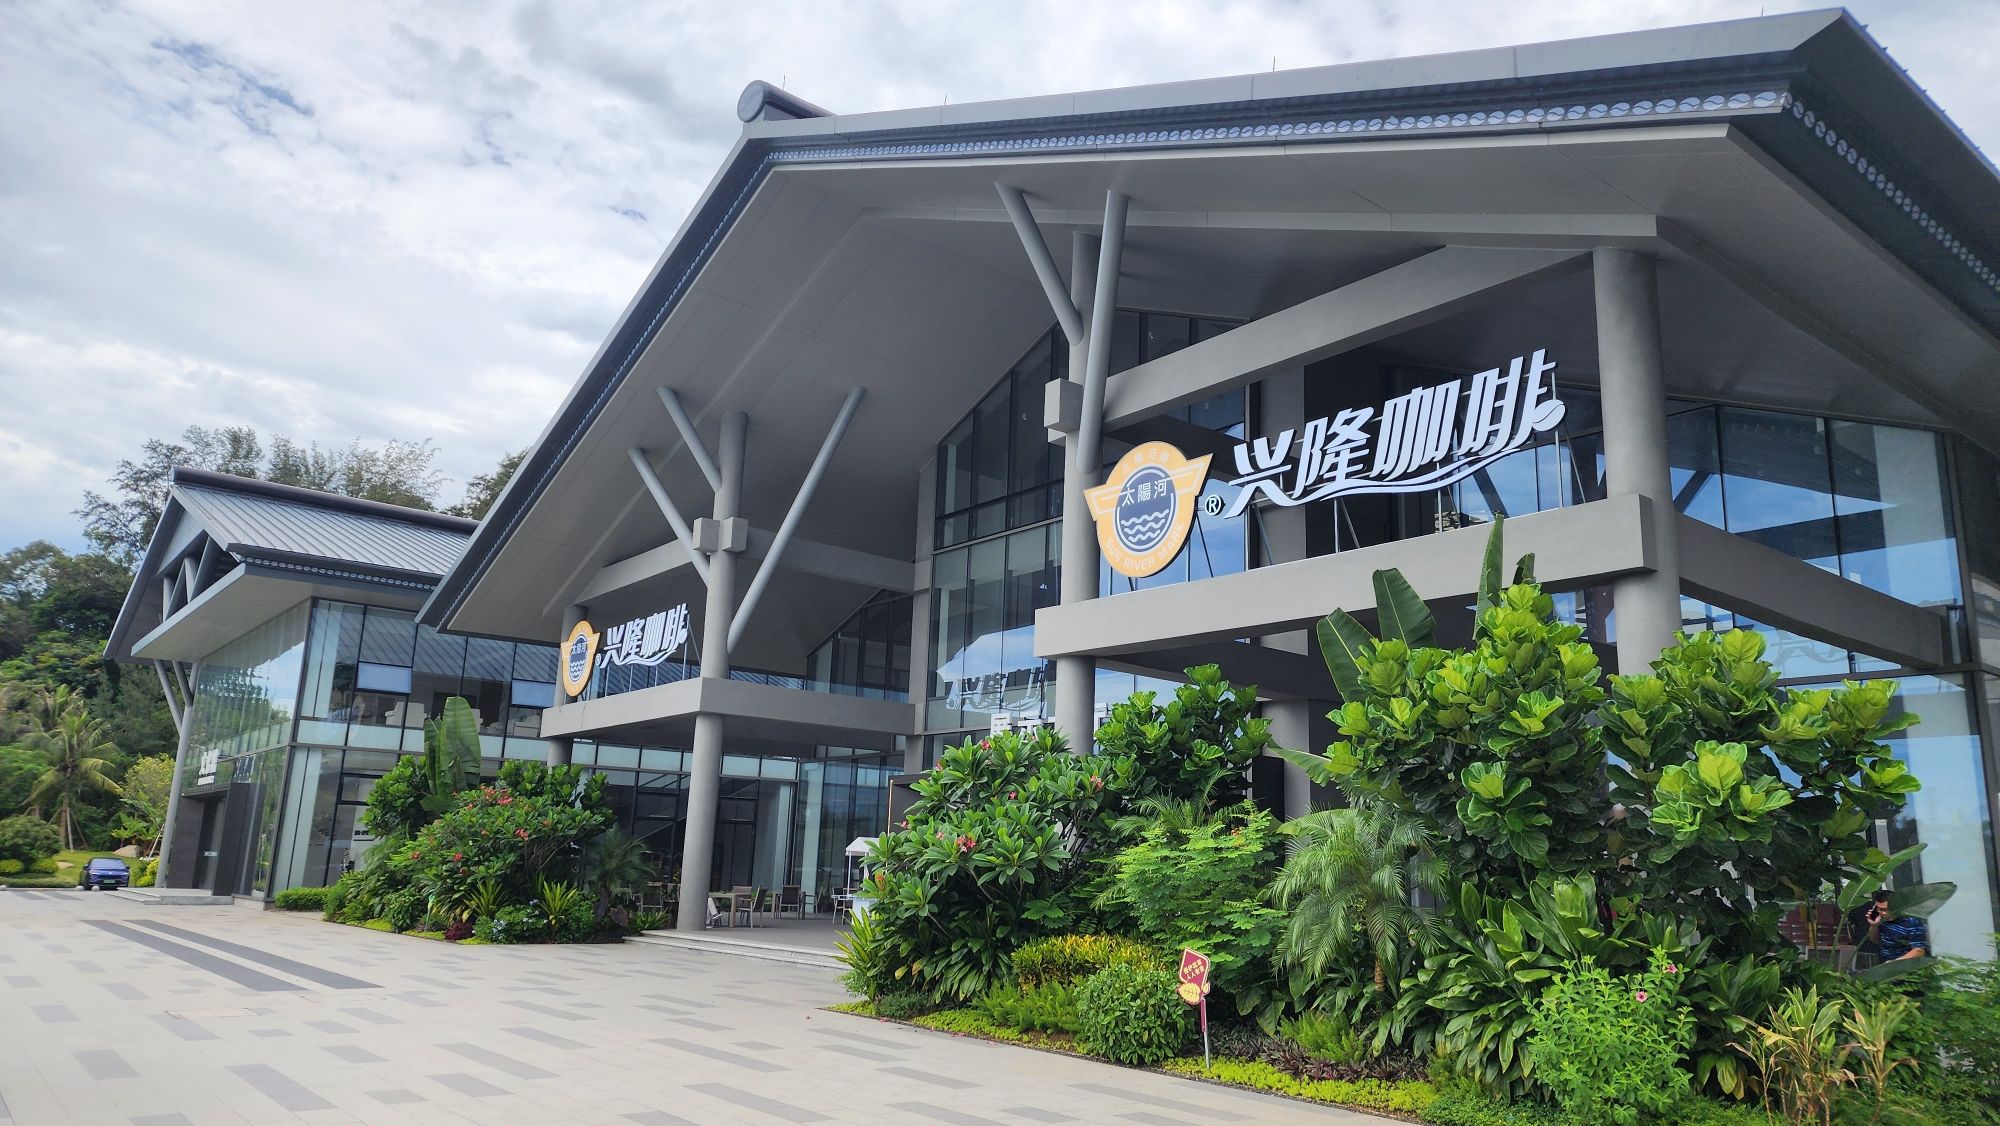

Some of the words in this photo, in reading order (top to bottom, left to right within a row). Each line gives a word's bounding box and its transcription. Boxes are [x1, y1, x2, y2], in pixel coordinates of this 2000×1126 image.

[1223, 348, 1564, 518] 兴隆咖啡
[1121, 479, 1168, 507] 太陽河
[1105, 537, 1123, 562] SUN
[1123, 557, 1156, 571] RIVER
[600, 603, 688, 668] 兴隆咖啡
